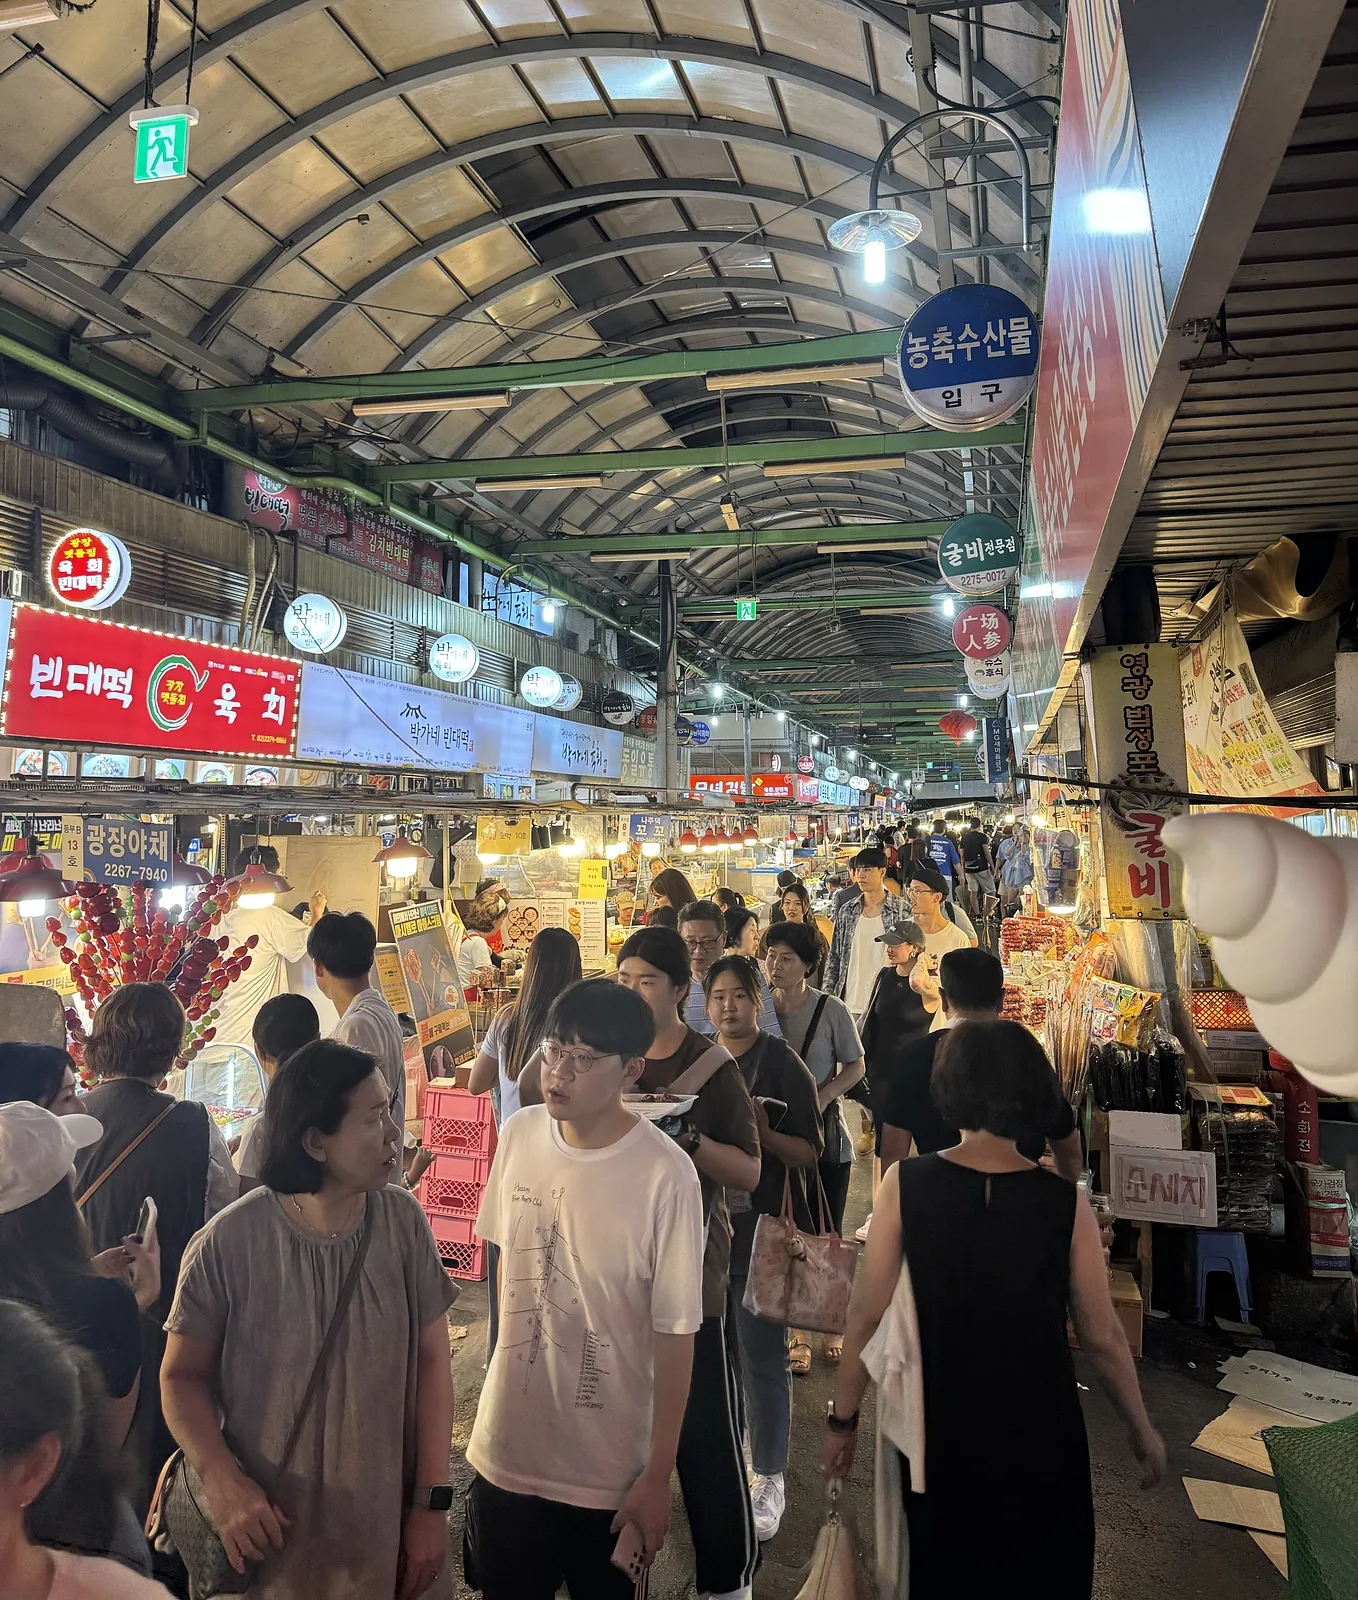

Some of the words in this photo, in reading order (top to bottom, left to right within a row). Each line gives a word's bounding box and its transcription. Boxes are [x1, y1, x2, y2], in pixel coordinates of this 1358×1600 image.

[906, 316, 1032, 369] 농축수산물
[244, 486, 291, 530] 빈대떡
[298, 503, 317, 528] 명품
[57, 574, 103, 592] 빈대떡
[960, 569, 1008, 587] 2275-0072
[962, 612, 999, 634] 广场
[964, 631, 1002, 652] 人参
[29, 653, 134, 709] 빈대떡
[985, 668, 1004, 678] 후식
[1120, 652, 1154, 700] 영광
[410, 721, 441, 747] 박가네
[443, 726, 470, 752] 빈대떡
[1123, 703, 1159, 774] 법성포
[622, 748, 656, 780] 동일유통
[621, 822, 627, 831] 8
[67, 839, 79, 851] 13
[86, 824, 169, 863] 광장야채
[67, 855, 78, 867] 호
[104, 862, 168, 882] 2267-7940
[1310, 1178, 1344, 1190] 국가검정
